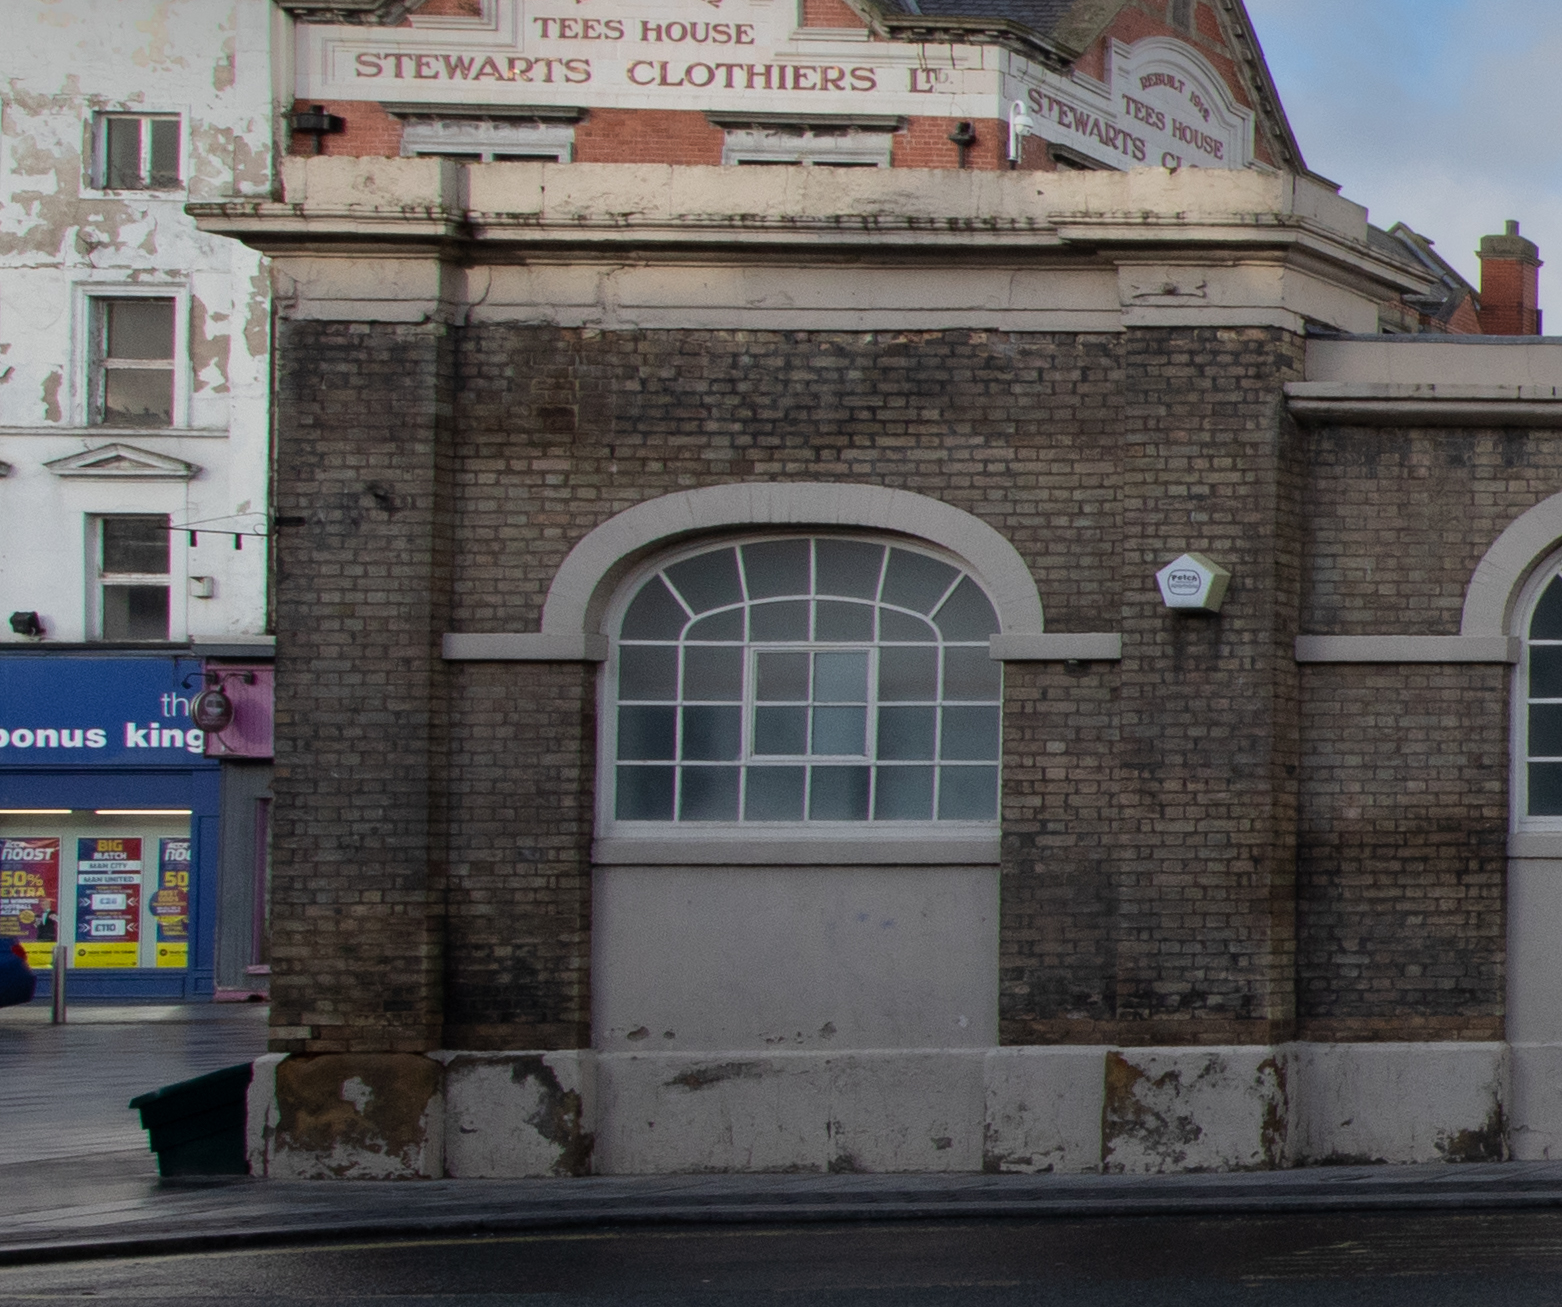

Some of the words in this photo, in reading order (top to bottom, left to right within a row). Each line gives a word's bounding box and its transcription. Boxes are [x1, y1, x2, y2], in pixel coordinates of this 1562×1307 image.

[533, 17, 625, 40] TEES
[640, 20, 755, 44] HOUSE
[355, 51, 592, 84] STEWARTS
[626, 60, 877, 92] CLOTHIERS
[1139, 72, 1186, 93] REBUILT
[1189, 91, 1211, 122] 1912
[1028, 88, 1146, 161] STEWARTS
[1122, 94, 1166, 131] TEES
[1171, 117, 1224, 160] HOUSE
[161, 692, 189, 718] th
[125, 722, 206, 754] king
[93, 852, 127, 860] MATCH
[97, 839, 123, 852] BIG
[1, 871, 44, 886] 50%
[1, 887, 46, 897] EXTRA
